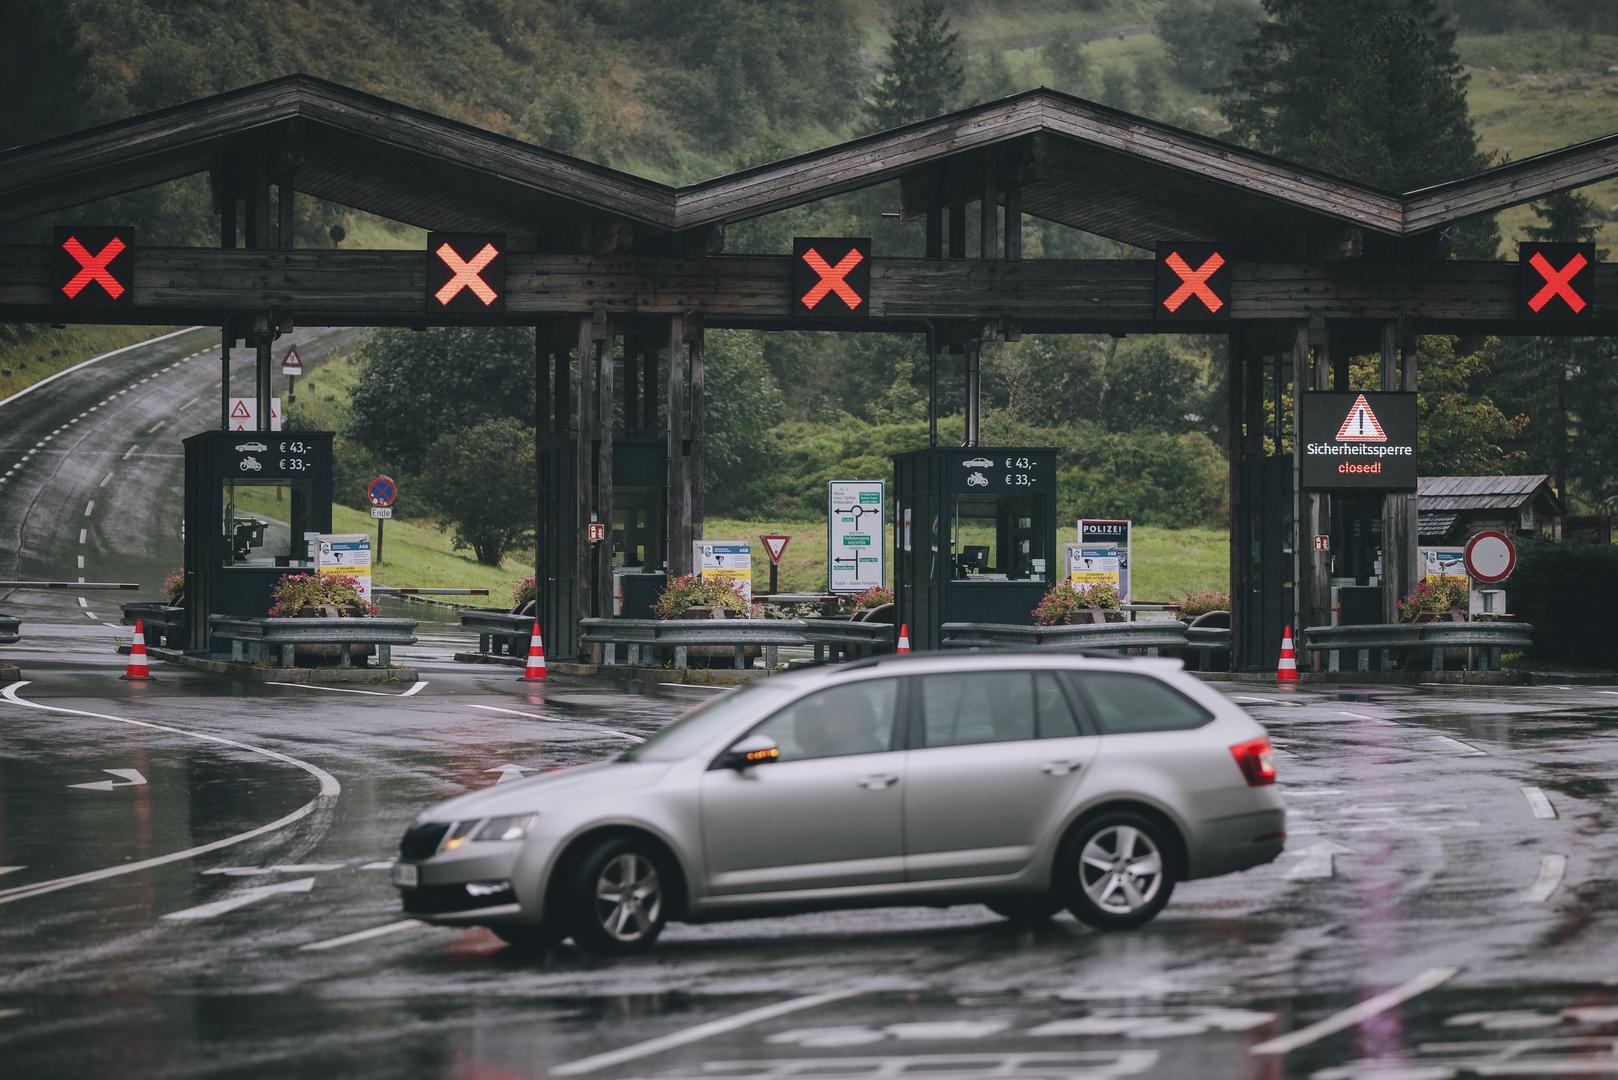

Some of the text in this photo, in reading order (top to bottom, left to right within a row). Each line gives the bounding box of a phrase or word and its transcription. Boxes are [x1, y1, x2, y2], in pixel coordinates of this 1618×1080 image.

[280, 442, 312, 454] € 43,-
[1307, 443, 1412, 457] Sicherheitssperre
[280, 459, 311, 472] € 33,-
[1006, 458, 1037, 470] € 43,-
[1338, 461, 1382, 474] closed!
[1005, 475, 1036, 486] € 33,-
[371, 509, 391, 517] Ende
[1083, 525, 1122, 533] POLIZEI
